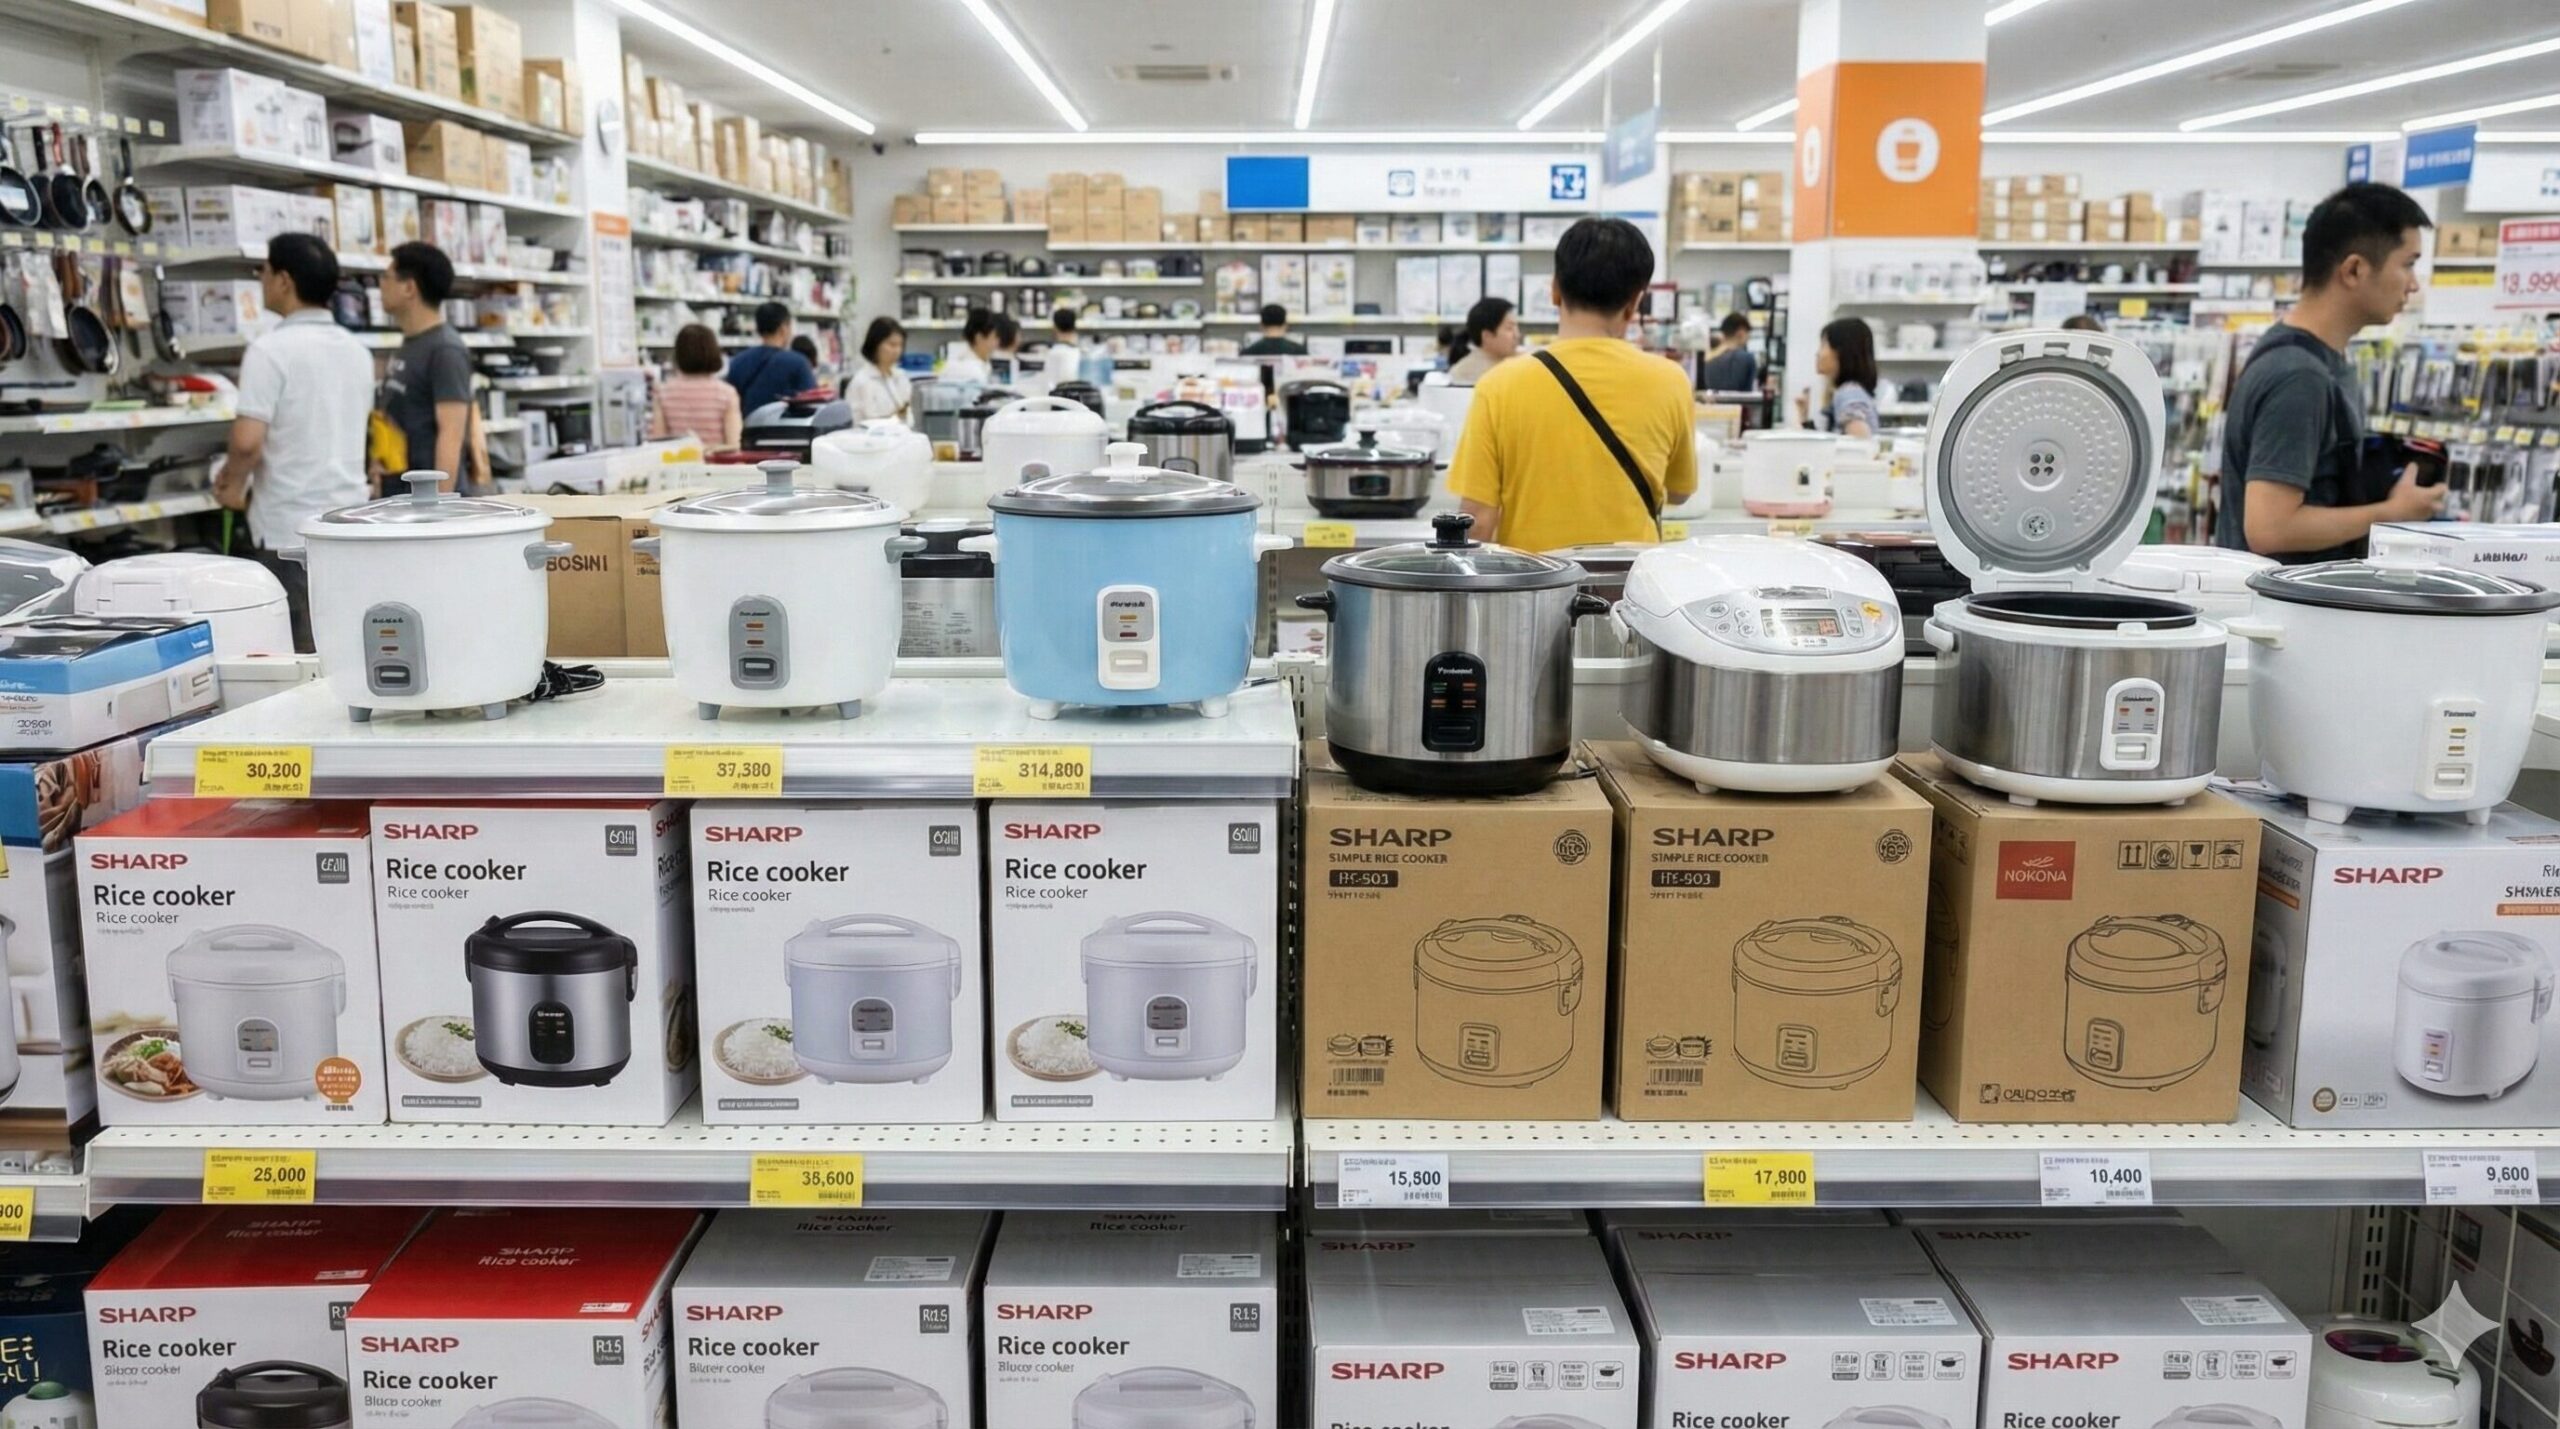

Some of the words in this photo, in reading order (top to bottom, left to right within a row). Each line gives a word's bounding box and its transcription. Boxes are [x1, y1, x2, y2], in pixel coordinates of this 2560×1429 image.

[384, 823, 479, 840] SHARP
[705, 826, 803, 842] SHARP
[1004, 823, 1101, 839] SHARP
[1329, 828, 1452, 847] SHARP
[1653, 828, 1774, 846] SHARP
[91, 853, 188, 870] SHARP
[387, 858, 437, 880] Rice
[444, 858, 527, 880] cooker
[1006, 858, 1057, 879] Rice
[1064, 858, 1147, 880] cooker
[708, 860, 759, 882] Rice
[766, 860, 850, 882] cooker
[2004, 870, 2067, 882] NOKONA
[2333, 866, 2444, 885] SHARP
[94, 884, 146, 906] Rice
[153, 884, 236, 906] cooker
[388, 886, 417, 899] Rice
[421, 886, 469, 899] cooker
[708, 888, 739, 901] Rice
[742, 888, 792, 902] cooker
[1006, 886, 1036, 899] Rice
[1040, 886, 1088, 899] cooker
[96, 911, 127, 924] Rice
[131, 911, 179, 924] cooker
[2090, 1168, 2142, 1184] 10,400
[2486, 1166, 2530, 1183] 9,600
[1637, 1231, 1733, 1241] SHARP
[1937, 1231, 2032, 1241] SHARP
[1320, 1241, 1415, 1251] SHARP
[99, 1306, 197, 1324] SHARP
[686, 1305, 784, 1321] SHARP
[997, 1303, 1093, 1320] SHARP
[103, 1339, 151, 1359] Rice
[158, 1338, 237, 1358] cooker
[361, 1336, 460, 1353] SHARP
[688, 1337, 736, 1356] Rice
[743, 1337, 820, 1356] cooker
[998, 1336, 1046, 1355] Rice
[1052, 1336, 1130, 1355] cooker
[1674, 1352, 1787, 1370] SHARP
[2008, 1352, 2120, 1370] SHARP
[1331, 1362, 1445, 1380] SHARP
[363, 1370, 412, 1389] Rice
[419, 1370, 498, 1390] cooker
[1672, 1412, 1715, 1429] Rice
[1721, 1412, 1790, 1429] cooker
[2004, 1412, 2049, 1429] Rice
[2052, 1412, 2121, 1429] cooker
